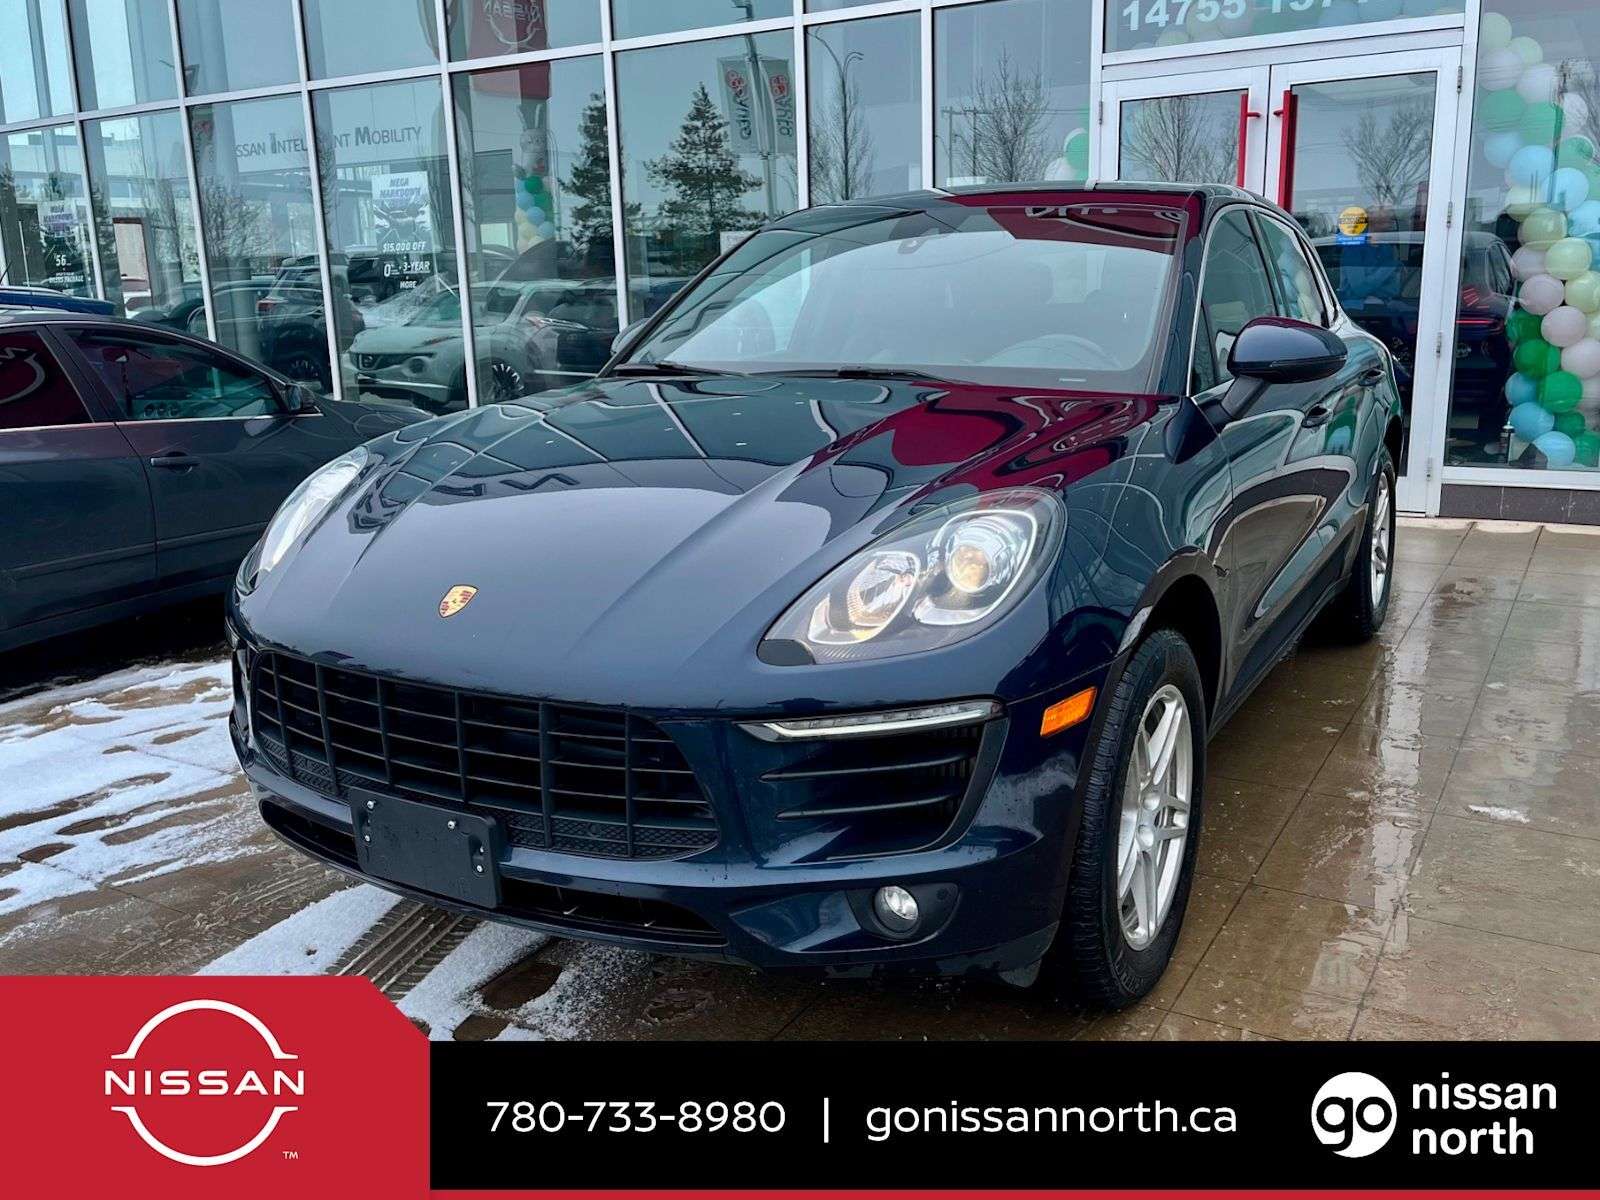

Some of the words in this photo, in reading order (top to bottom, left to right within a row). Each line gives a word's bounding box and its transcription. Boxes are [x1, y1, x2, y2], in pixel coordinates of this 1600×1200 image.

[1122, 0, 1247, 31] 14755
[270, 132, 350, 154] INTELNT
[355, 126, 422, 147] MOBILITY
[412, 240, 426, 251] OFF
